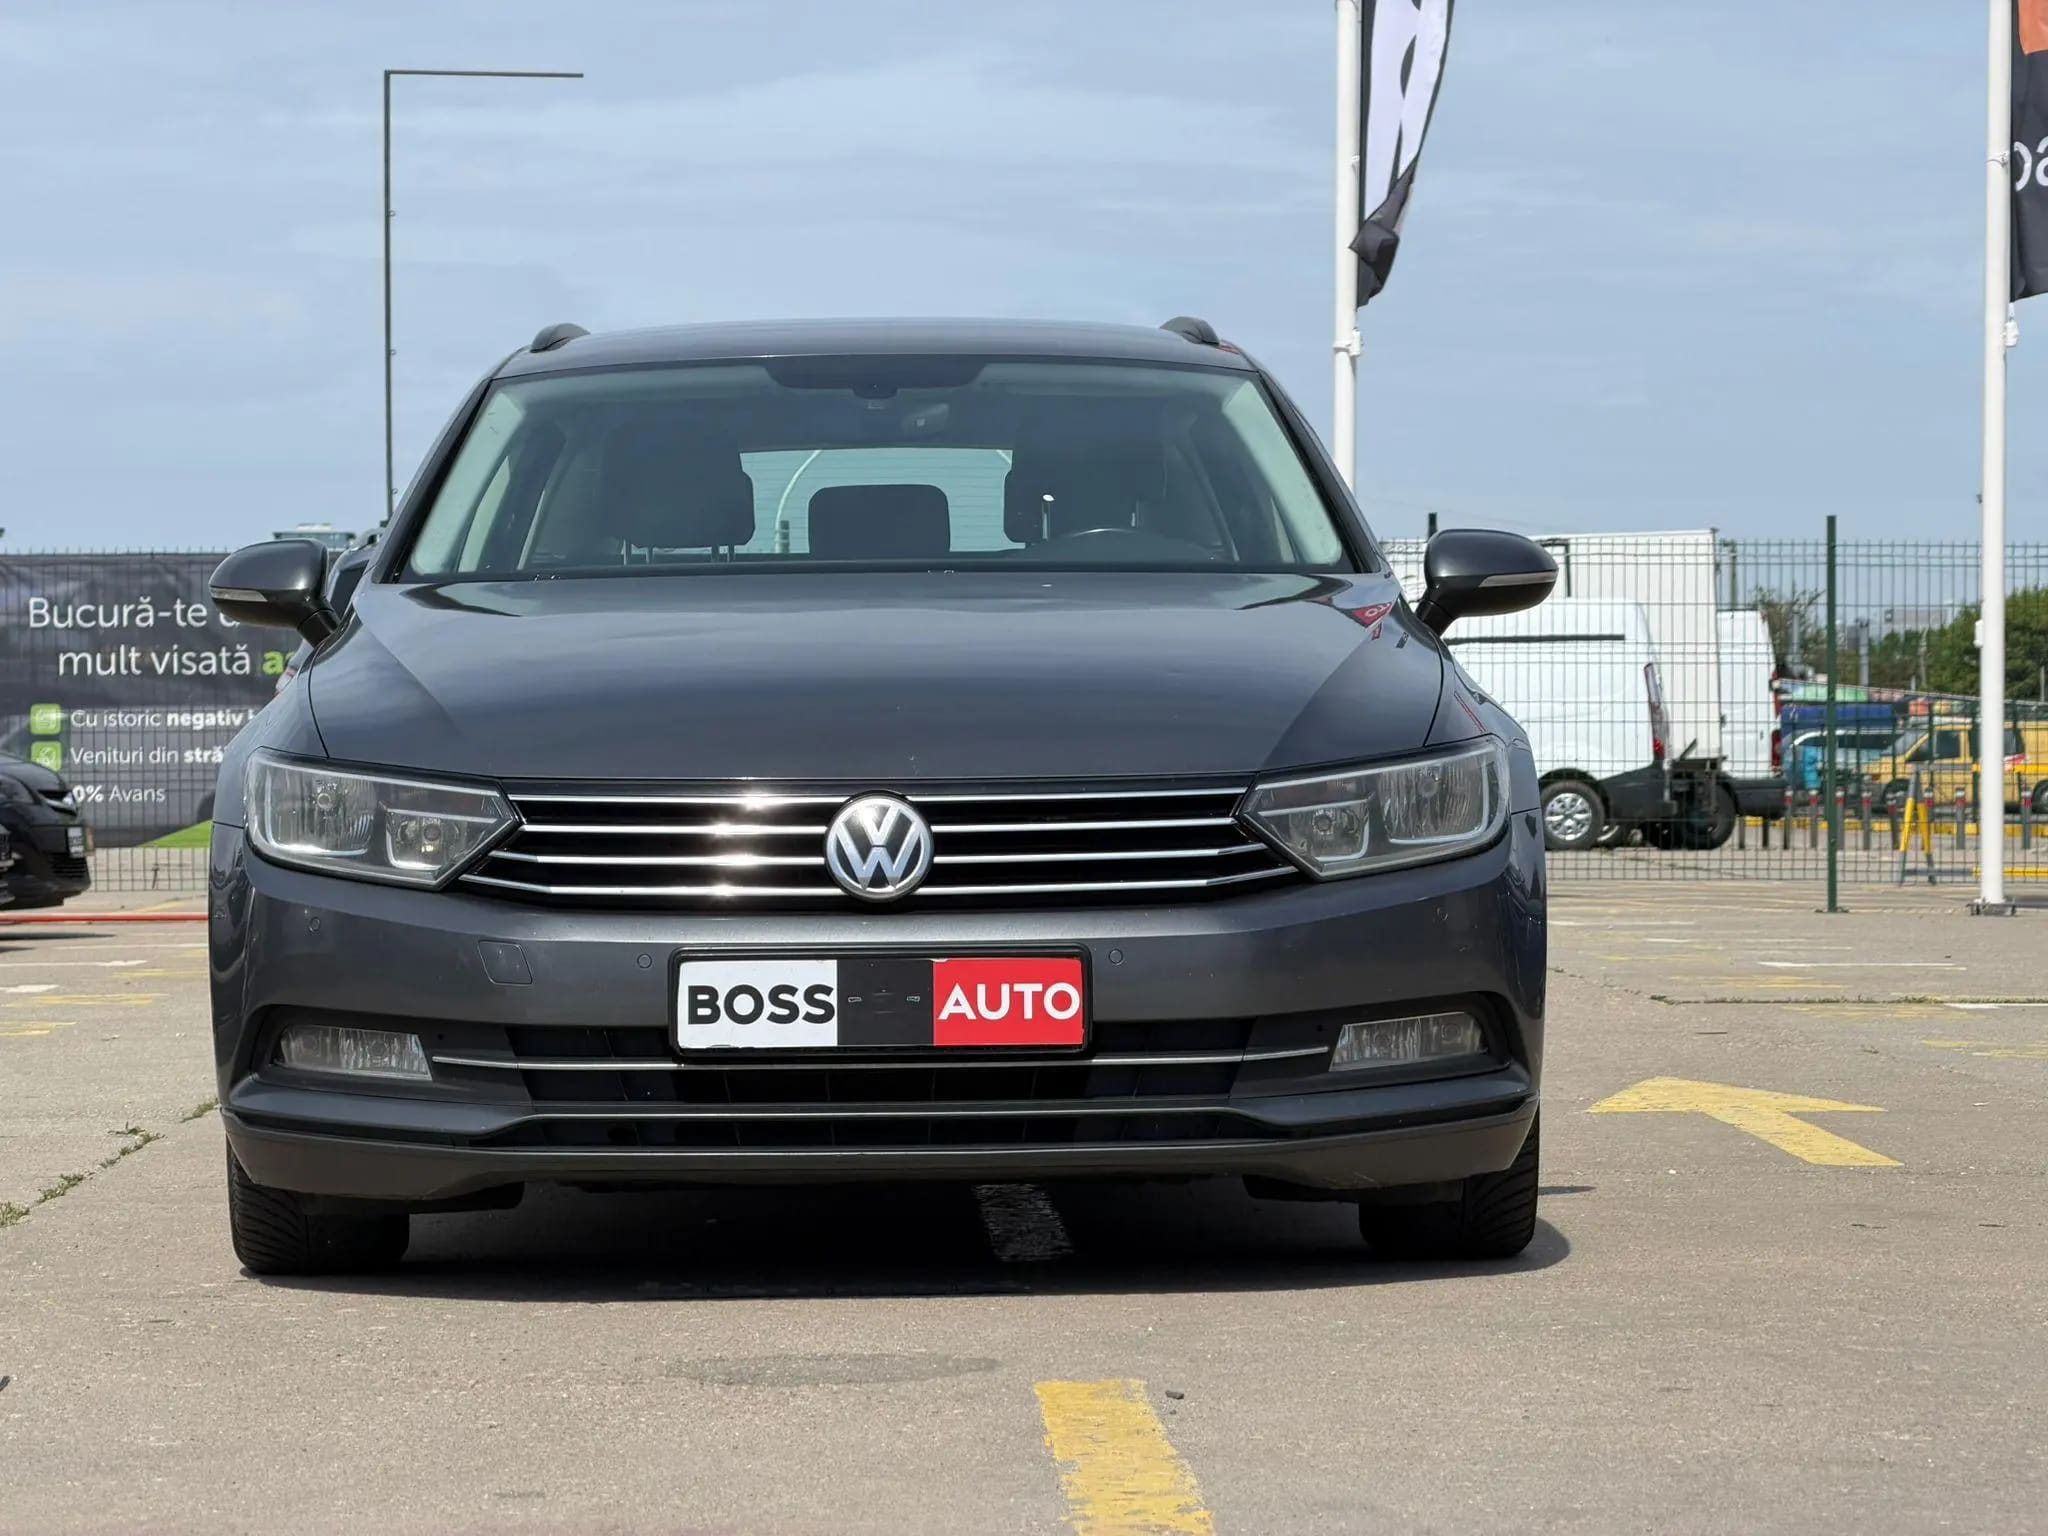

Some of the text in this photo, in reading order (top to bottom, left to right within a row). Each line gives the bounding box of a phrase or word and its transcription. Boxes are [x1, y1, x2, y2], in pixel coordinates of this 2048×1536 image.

[28, 597, 207, 629] Bucură-te
[58, 645, 142, 676] mult
[150, 645, 250, 676] visată
[70, 709, 244, 730] Cu istoric negativ
[70, 746, 224, 764] Venituri din stră
[72, 785, 166, 803] 0% Avans
[687, 982, 1081, 1026] BOSS AUTO
